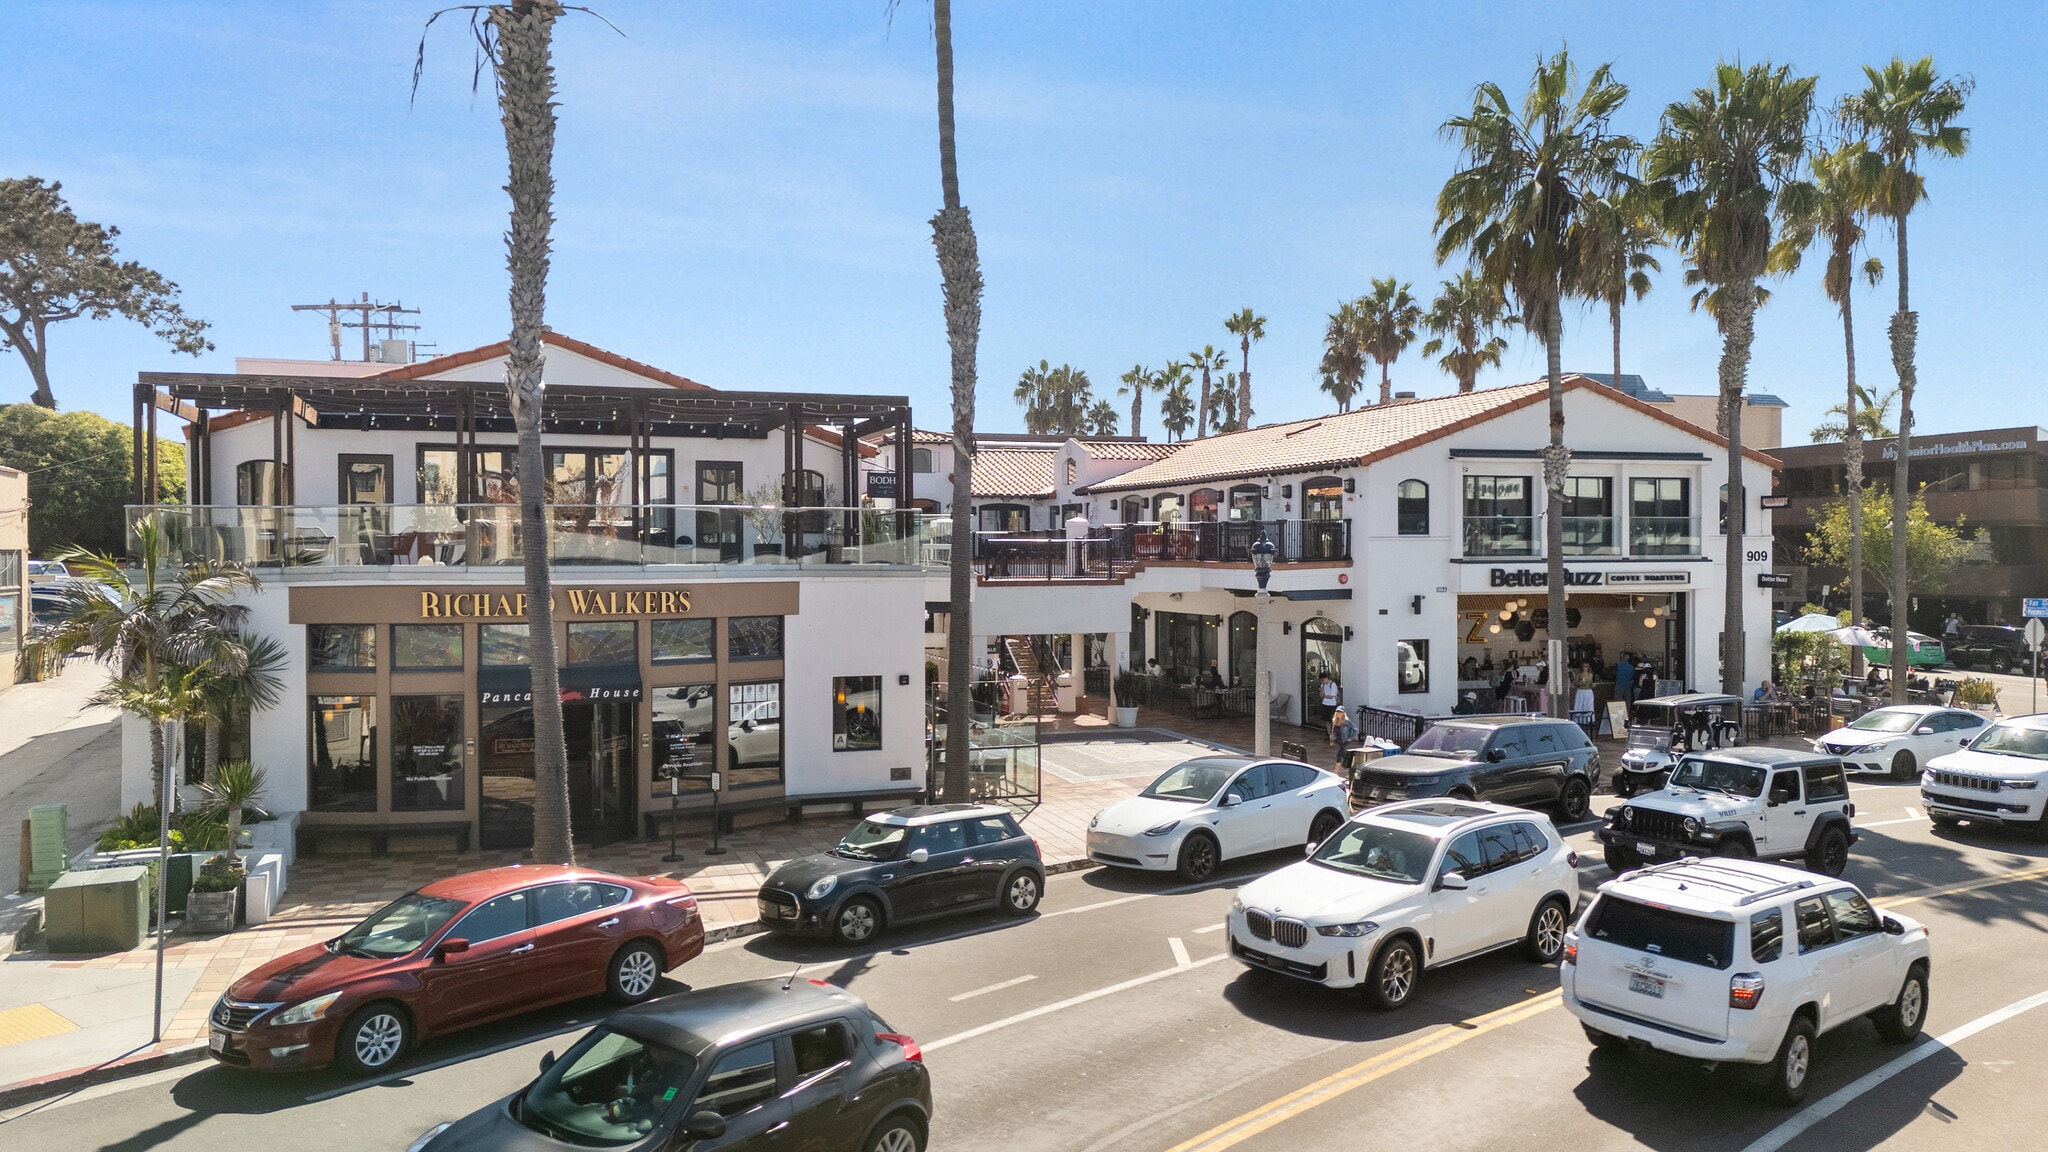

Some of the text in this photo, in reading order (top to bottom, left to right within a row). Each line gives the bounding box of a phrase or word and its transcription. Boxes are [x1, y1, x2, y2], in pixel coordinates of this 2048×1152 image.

[1882, 440, 2027, 460] MyeniorHealthPlan.com
[1746, 551, 1768, 561] 909
[1644, 574, 1686, 582] ROASTERS
[566, 589, 691, 615] WALKER'S
[481, 687, 640, 703] Panca House
